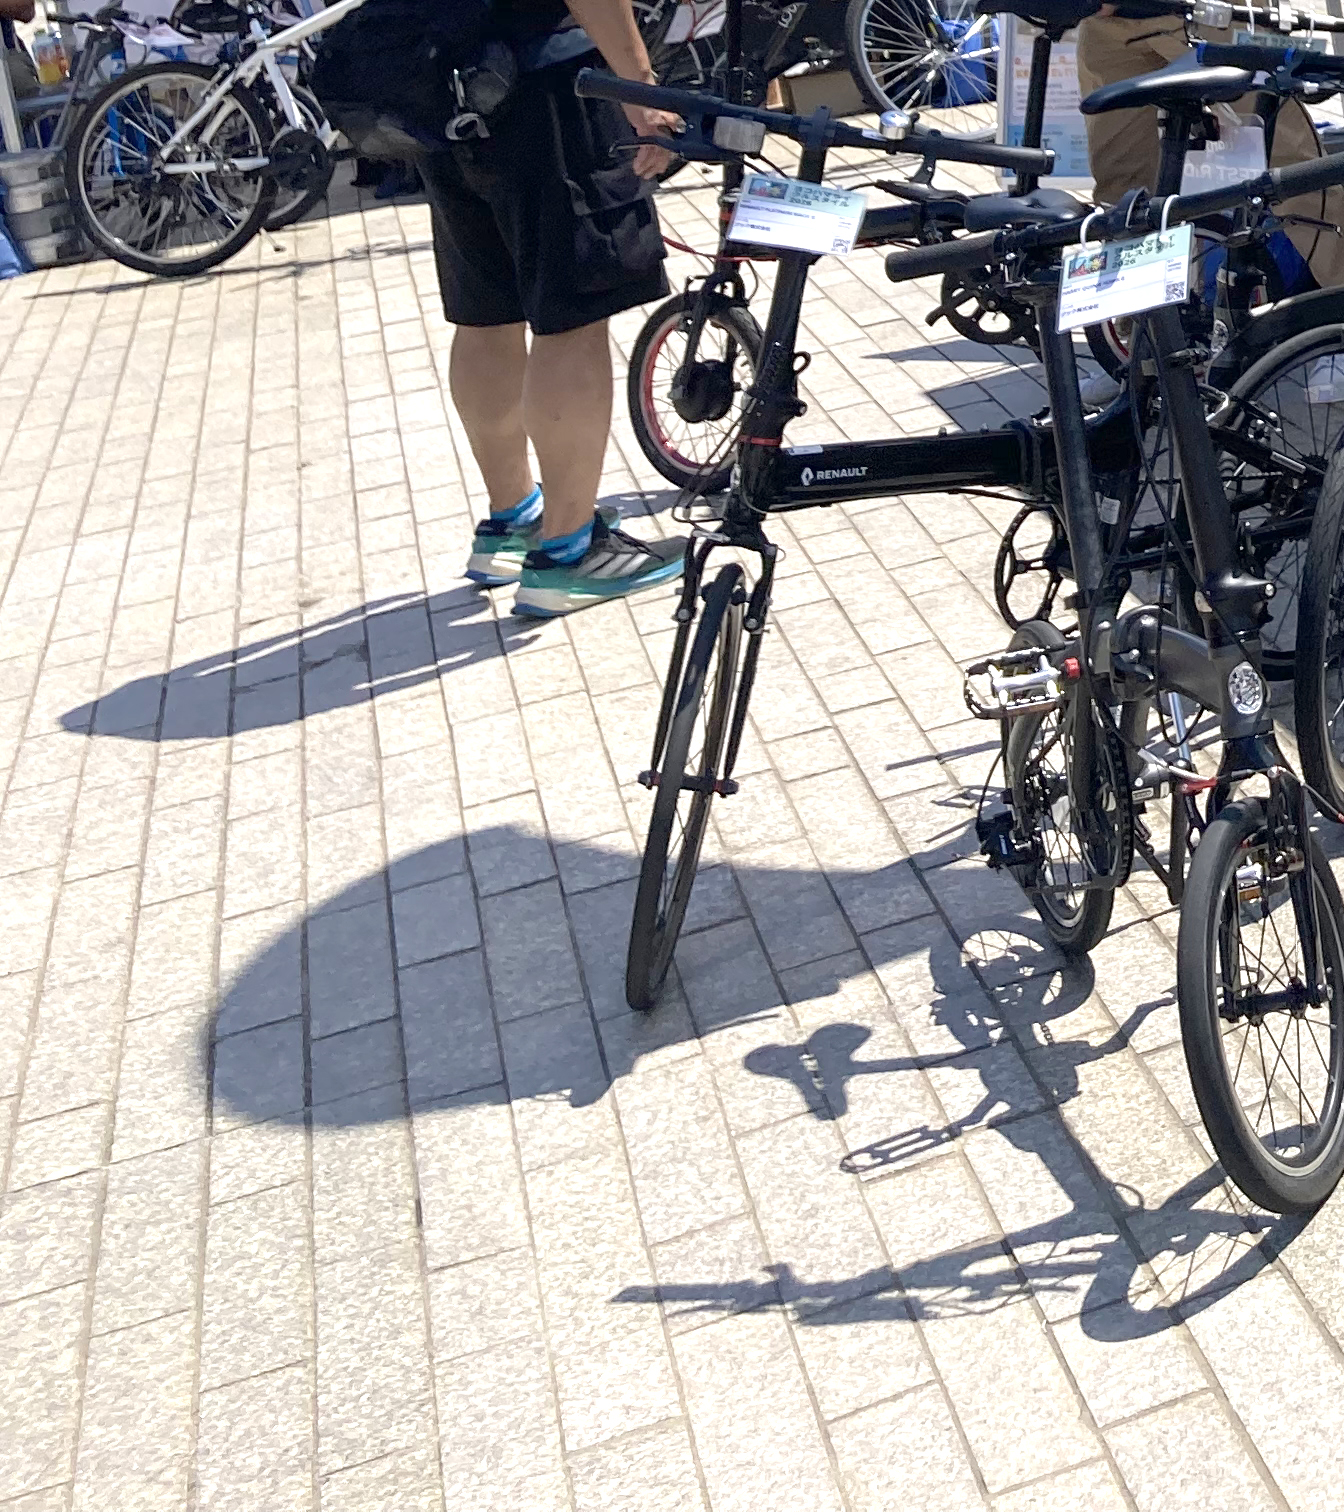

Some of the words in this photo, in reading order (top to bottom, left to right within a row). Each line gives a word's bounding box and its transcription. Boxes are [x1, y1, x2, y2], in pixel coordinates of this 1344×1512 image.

[1115, 233, 1176, 254] ヨコハマイ
[1112, 257, 1136, 269] 2026
[817, 466, 868, 481] RENAULT
